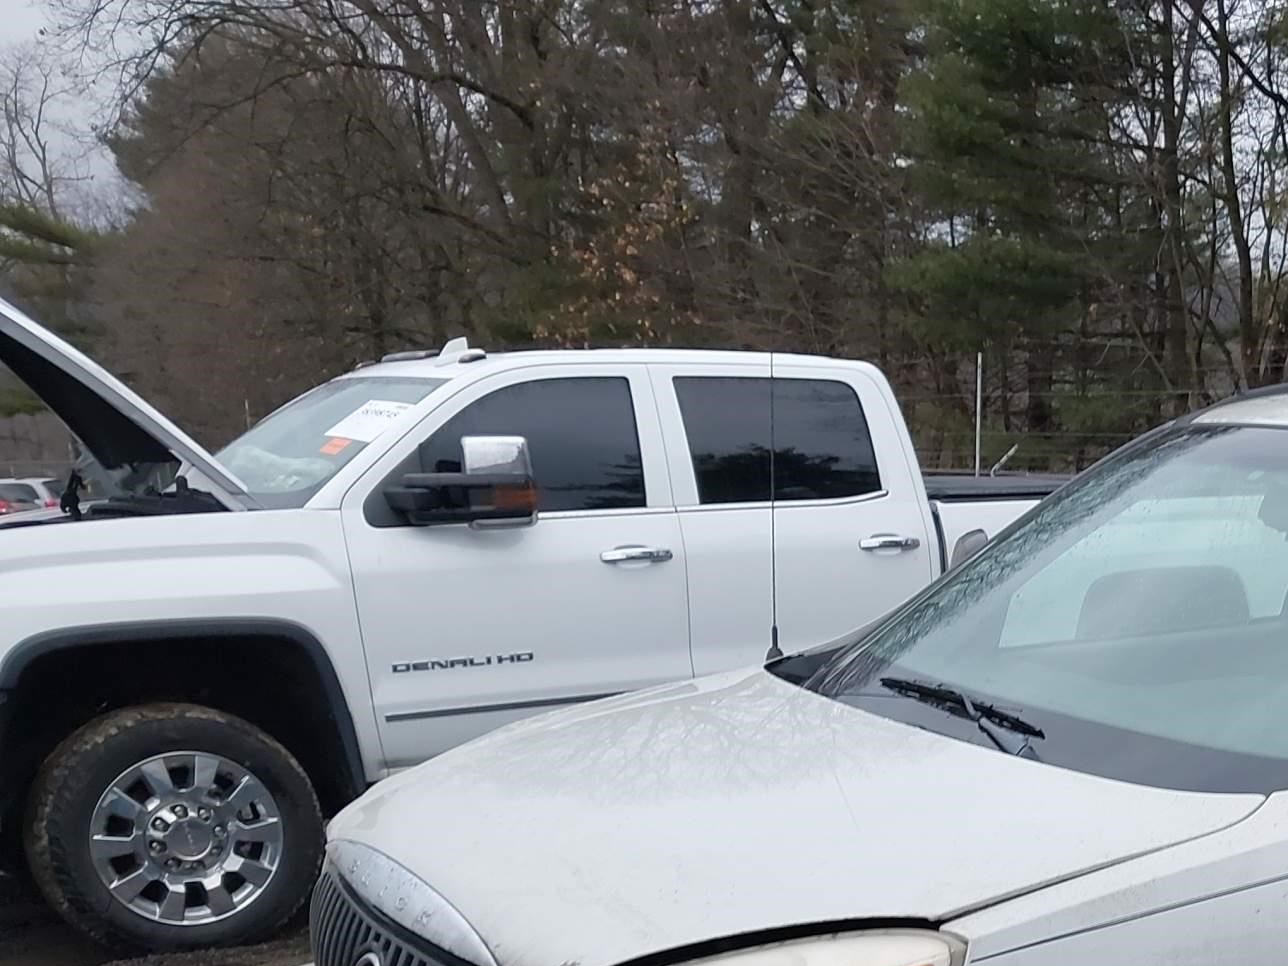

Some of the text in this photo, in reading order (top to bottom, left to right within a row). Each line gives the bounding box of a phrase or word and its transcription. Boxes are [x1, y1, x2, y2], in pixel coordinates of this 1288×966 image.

[391, 651, 534, 673] DENALI HD
[347, 857, 433, 928] BUICK
